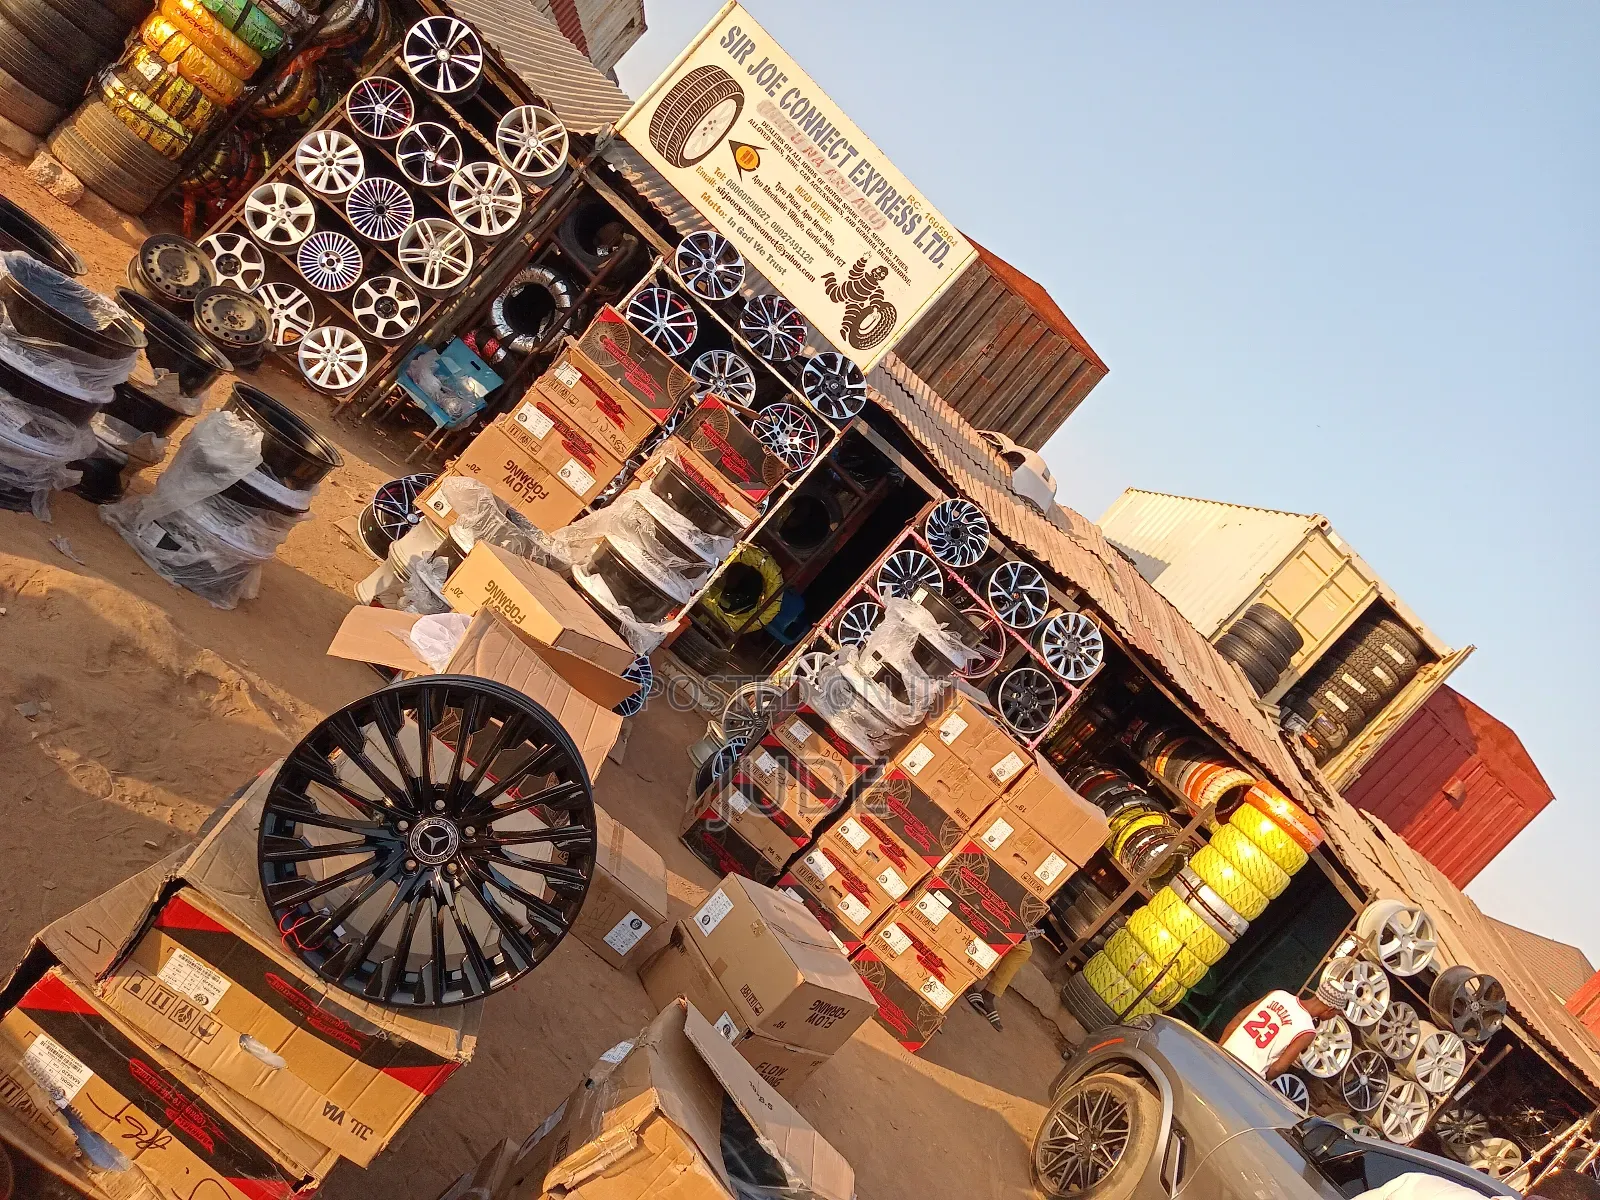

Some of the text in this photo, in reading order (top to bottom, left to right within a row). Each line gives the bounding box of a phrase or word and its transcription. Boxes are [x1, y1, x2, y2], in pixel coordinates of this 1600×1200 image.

[720, 25, 950, 270] SIR JOE CONNECT EXPRESS LTD.
[695, 164, 718, 188] Email:
[713, 166, 727, 182] Tel:
[747, 118, 772, 142] ALLOYED
[798, 169, 811, 182] CAR
[843, 215, 857, 228] AND
[854, 226, 878, 251] GENERAL
[760, 119, 786, 146] DEALERS
[783, 142, 794, 154] ON
[790, 151, 802, 163] ALL
[800, 160, 818, 179] KINDS
[816, 176, 826, 186] OF
[823, 184, 843, 204] MOTOR
[840, 202, 859, 221] SPARE
[870, 231, 886, 248] SUCH
[750, 174, 764, 188] Apo
[762, 185, 788, 212] Mechanic
[785, 207, 806, 232] Village,
[833, 254, 846, 268] FCT
[773, 180, 788, 197] Tyre
[785, 192, 803, 213] Plaza,
[800, 208, 814, 222] Apo
[810, 218, 826, 234] New
[794, 184, 833, 225] HEAD OFFICE:
[701, 192, 788, 277] Motto: In God We Trust
[925, 213, 958, 247] 1605964
[502, 475, 537, 503] FLOW
[503, 460, 550, 500] FORMING
[484, 580, 526, 624] FORMING
[804, 1011, 836, 1029] FLOW
[808, 998, 850, 1020] FORMING
[1266, 1000, 1292, 1026] JORDAN
[1243, 1010, 1280, 1049] 23
[755, 1062, 789, 1076] FLOW
[319, 1098, 348, 1127] VIA
